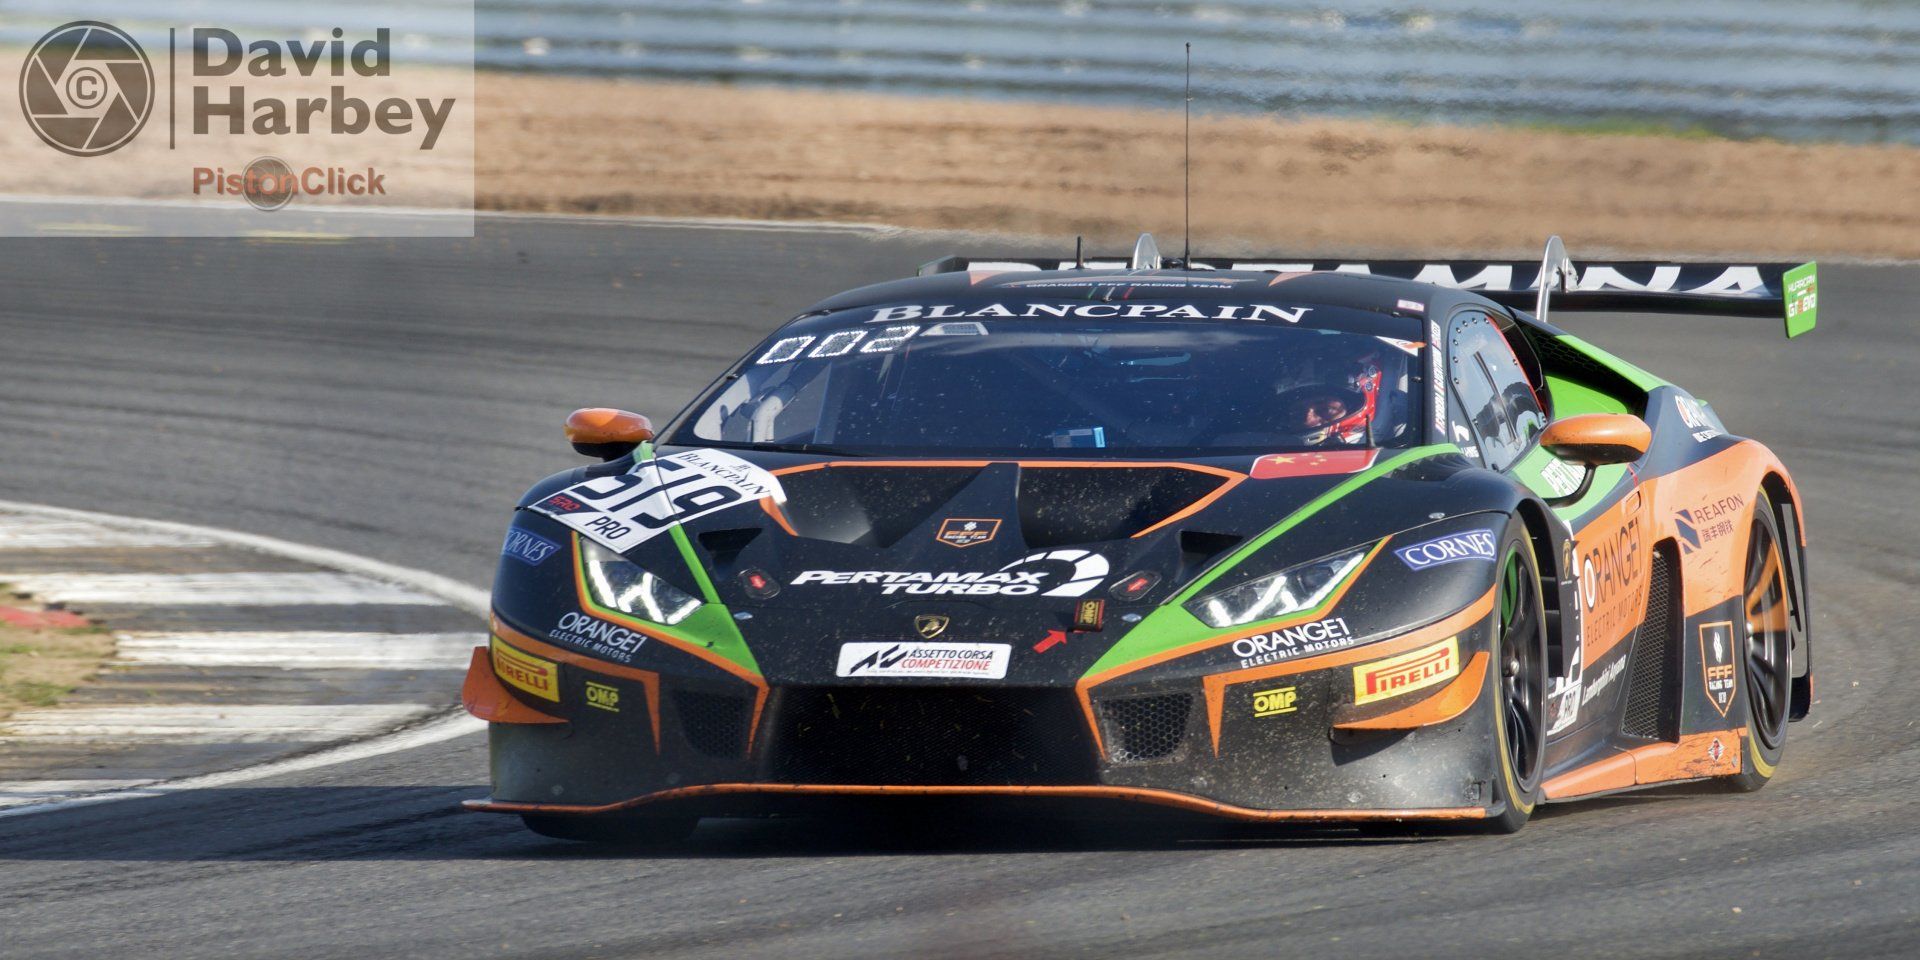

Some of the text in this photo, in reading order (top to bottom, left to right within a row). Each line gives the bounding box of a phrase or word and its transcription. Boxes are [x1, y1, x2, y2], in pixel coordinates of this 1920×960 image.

[864, 303, 1314, 324] BLANCPAIN
[676, 452, 773, 496] BLANCPAIN
[570, 458, 743, 530] 519
[1693, 494, 1745, 524] REAFON
[585, 515, 632, 541] PRO
[1405, 533, 1495, 566] CORNES
[790, 570, 1050, 586] PERTAMAX
[881, 583, 1040, 596] TURBO
[549, 629, 632, 663] ELECTRIC MOTORS
[557, 611, 648, 654] ORANGE1
[1232, 617, 1350, 658] ORANGE1
[901, 658, 991, 671] COMPETIZIONE
[910, 649, 995, 660] ASSETTO CORSA
[1240, 635, 1354, 669] ELECTRIC MOTORS
[495, 648, 549, 691] PIRELLI
[1366, 647, 1450, 695] PIRELLI
[1708, 664, 1733, 680] FFF
[586, 686, 619, 707] OMP
[1253, 691, 1297, 712] OMP
